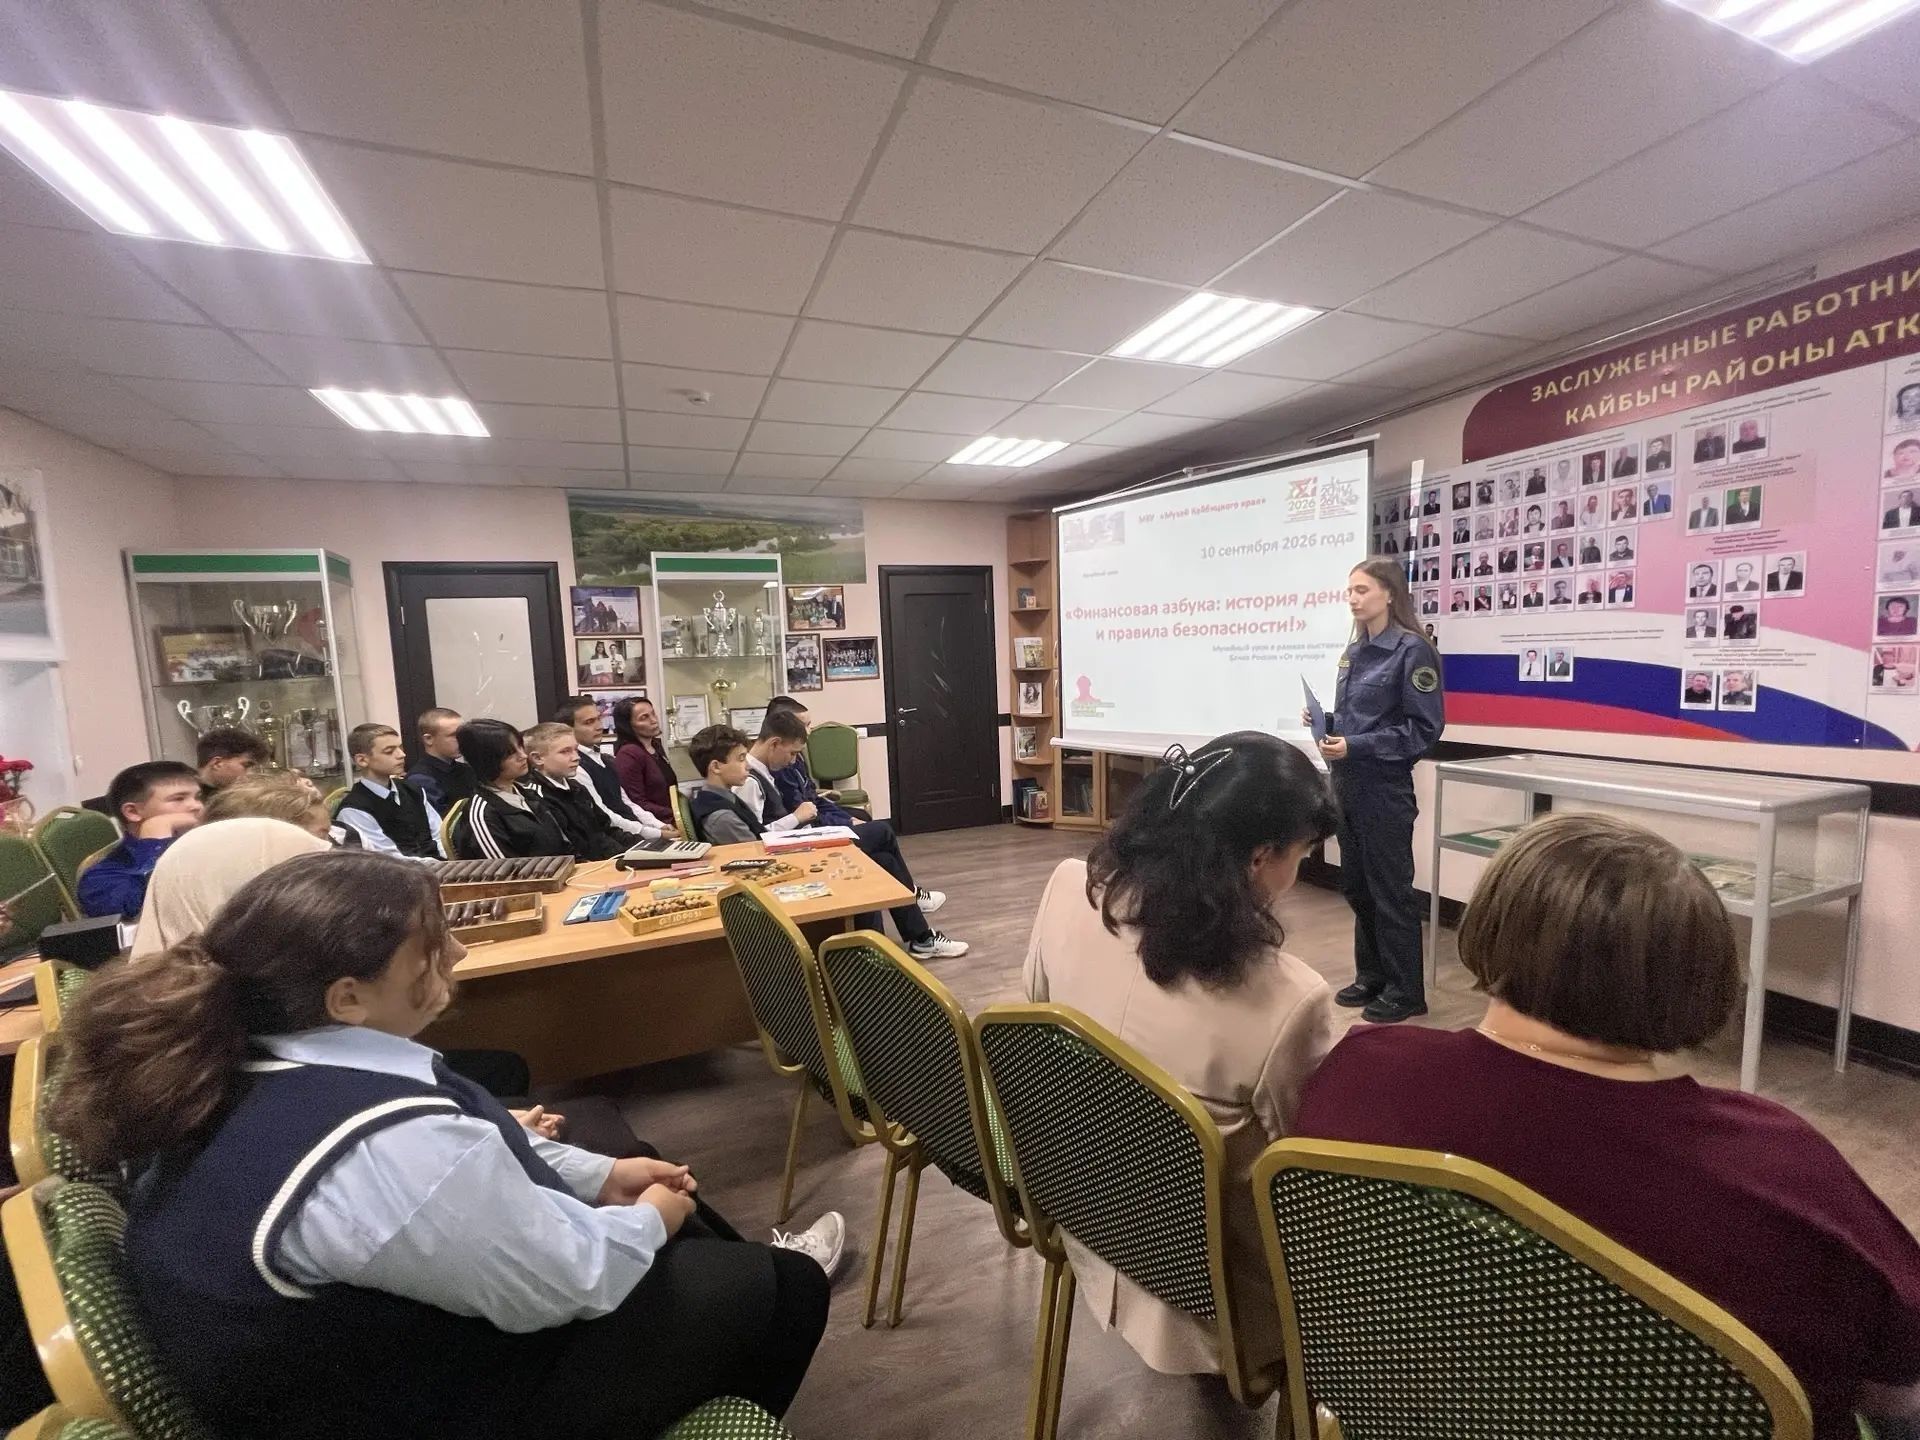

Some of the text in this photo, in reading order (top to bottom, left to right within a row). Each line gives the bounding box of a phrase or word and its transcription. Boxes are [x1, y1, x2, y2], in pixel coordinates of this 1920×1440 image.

[1531, 267, 1920, 403] ЗАСЛУЖЕННЫЕ РАБОТНИ
[1565, 382, 1678, 428] КАЙБЫЧ
[1685, 336, 1835, 396] РАЙОНЫ
[1844, 312, 1920, 354] АТК
[1201, 532, 1354, 559] 10 сентября 2026 года
[1065, 603, 1158, 620] «Финансовая
[1162, 598, 1220, 616] азбука:
[1225, 593, 1298, 611] история
[1096, 616, 1307, 642] и правила безопасности!»
